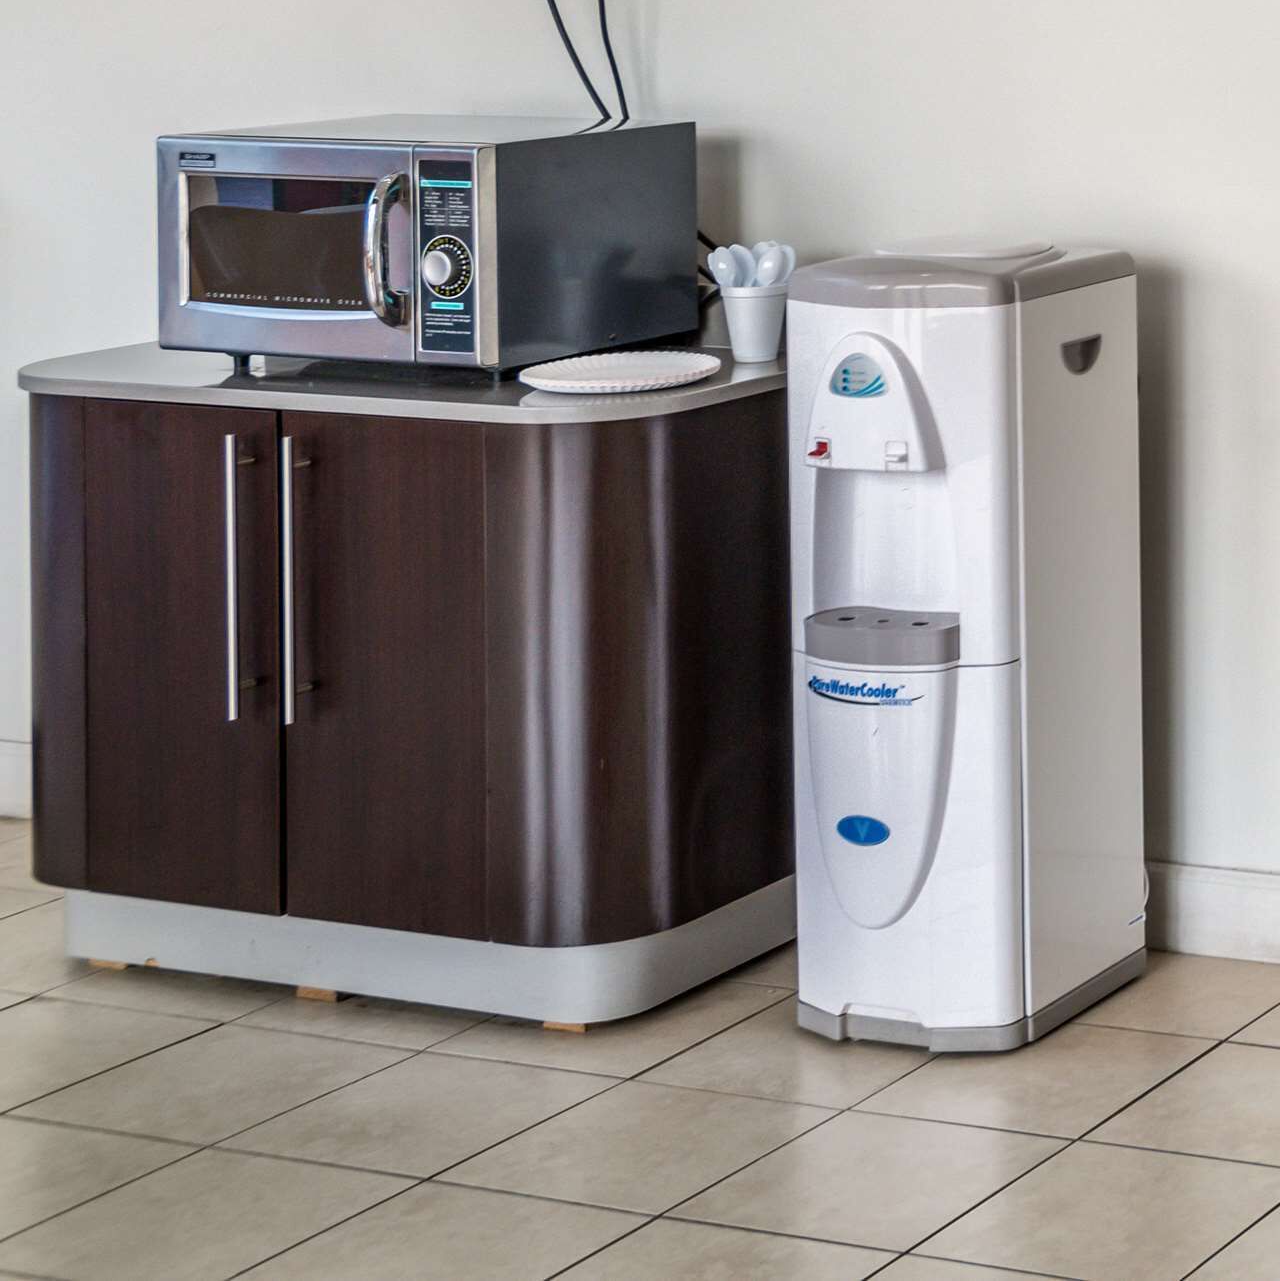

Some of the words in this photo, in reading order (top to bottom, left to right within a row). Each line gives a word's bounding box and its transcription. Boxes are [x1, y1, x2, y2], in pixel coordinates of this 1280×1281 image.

[207, 292, 268, 301] COMMERCIAL
[274, 295, 330, 304] MICROWAVE
[337, 298, 363, 306] OVEN
